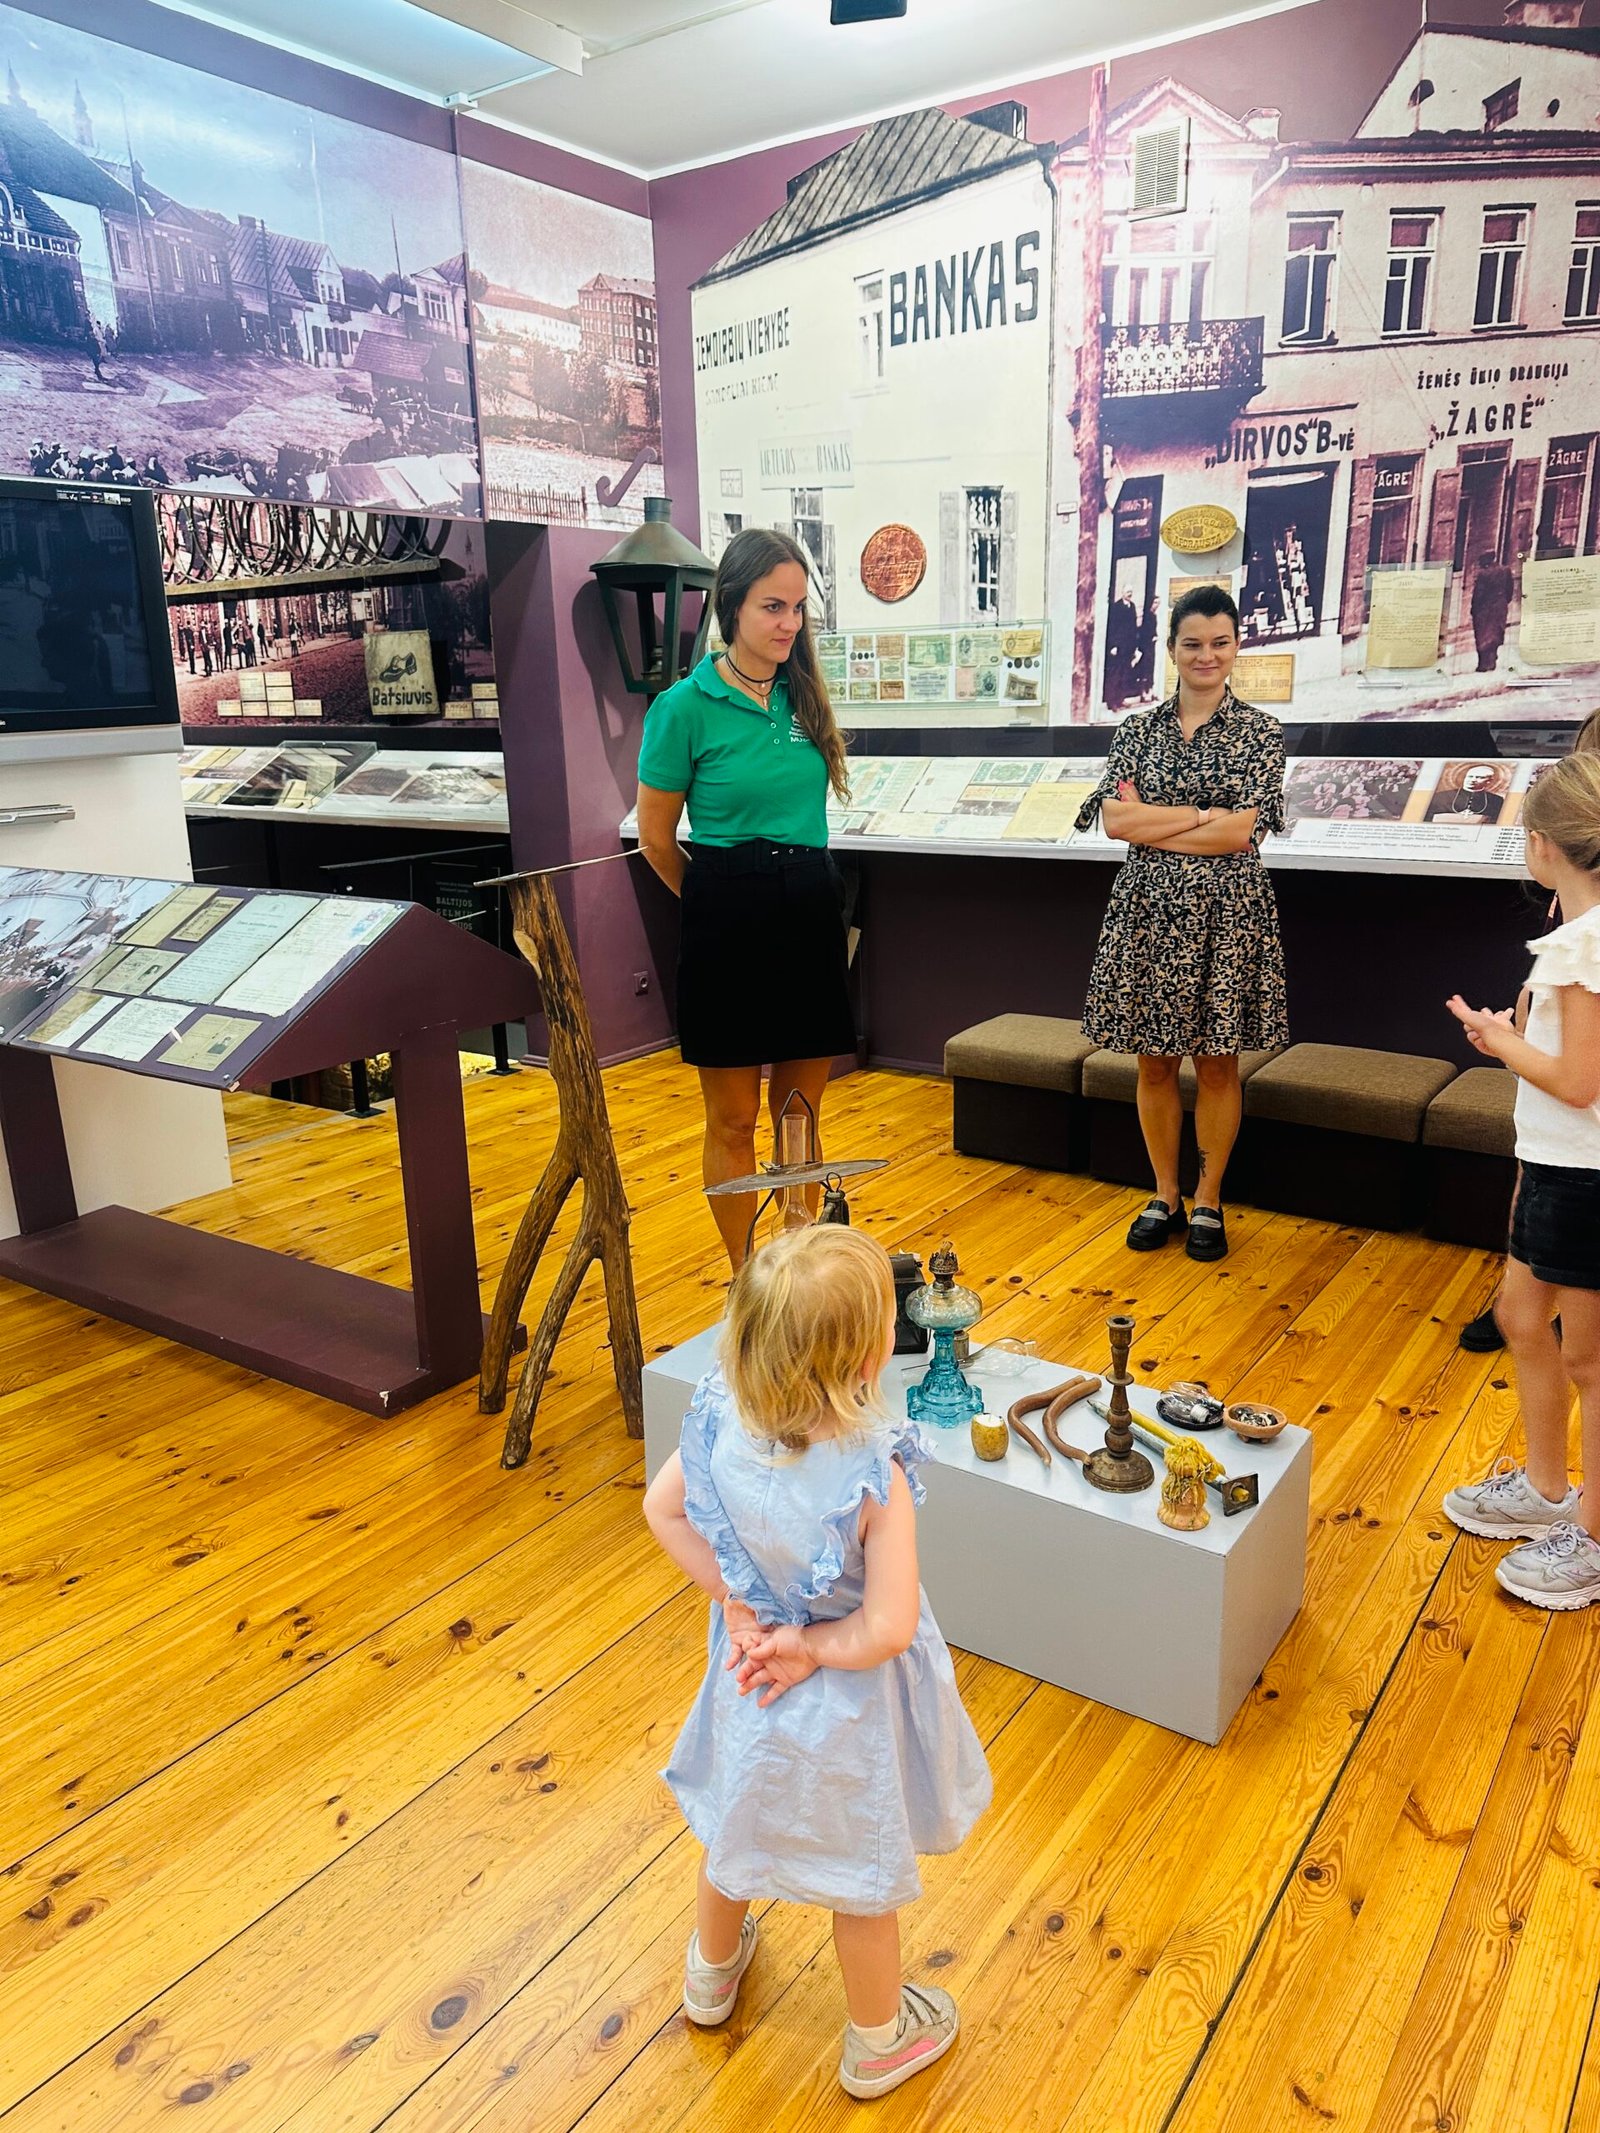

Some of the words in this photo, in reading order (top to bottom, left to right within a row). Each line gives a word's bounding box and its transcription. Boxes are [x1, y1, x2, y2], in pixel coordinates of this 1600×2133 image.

[890, 230, 1041, 347] BANKAS
[372, 686, 433, 706] Batsiuvis
[435, 896, 473, 908] BALTIJOS
